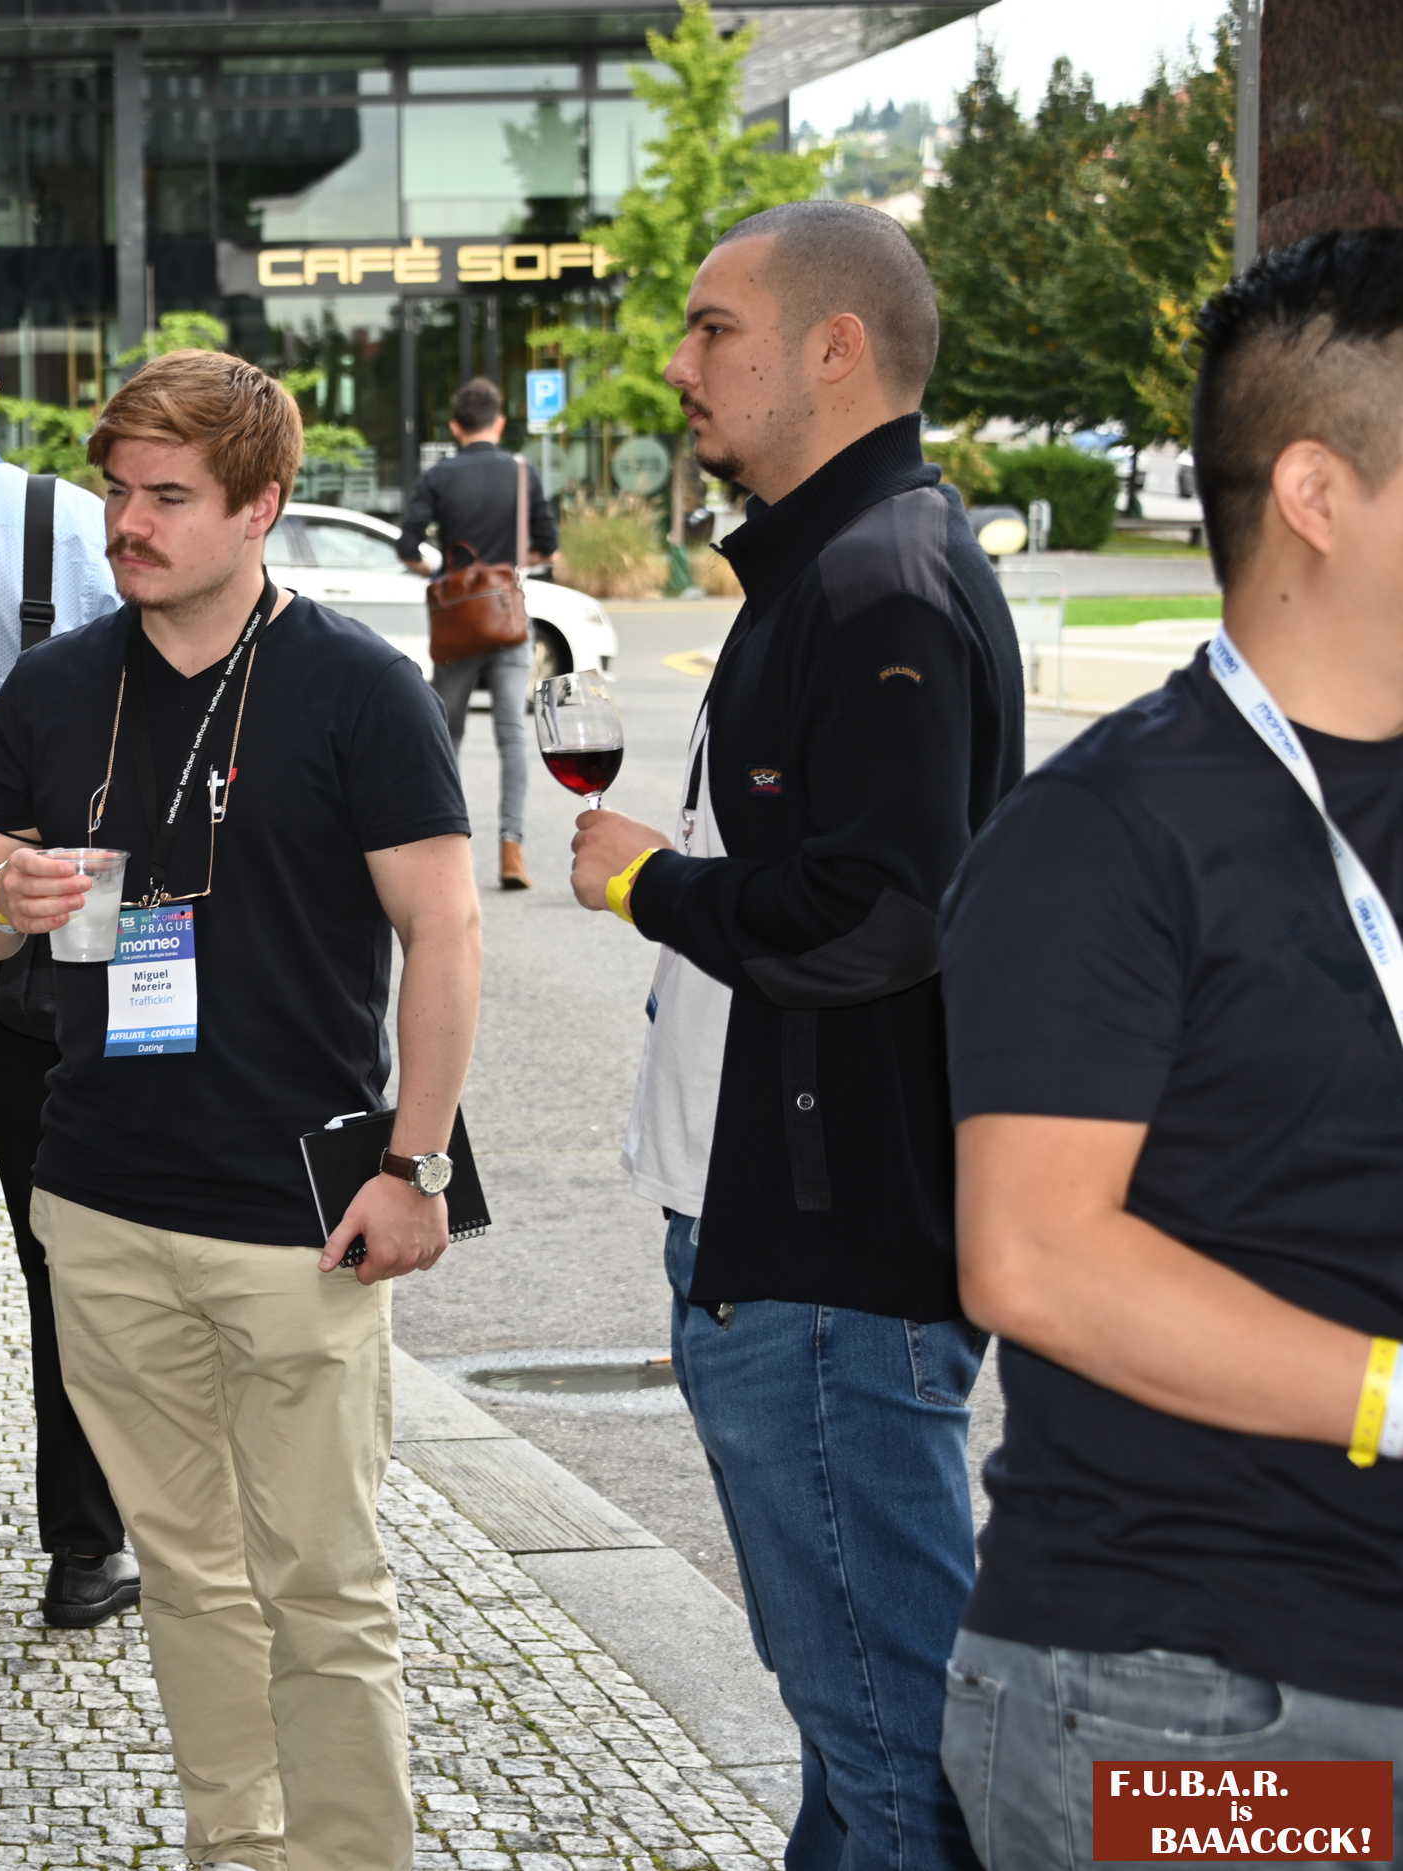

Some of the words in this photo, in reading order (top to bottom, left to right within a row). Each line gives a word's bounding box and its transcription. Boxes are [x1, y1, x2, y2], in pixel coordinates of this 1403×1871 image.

[258, 237, 441, 286] CAFÉ
[534, 380, 556, 408] P
[166, 788, 183, 824] traffickin'
[179, 751, 196, 786] traffickin'
[193, 715, 210, 749] traffickin'
[208, 679, 227, 712] traffickin'
[225, 644, 244, 675] traffickin'
[140, 920, 192, 934] PRAGUE
[120, 937, 180, 953] monneo
[134, 969, 168, 982] Miguel
[132, 981, 172, 992] Moreira
[110, 1031, 146, 1040] AFFILIATE
[151, 1027, 194, 1038] CORPORATE
[138, 1043, 164, 1053] Dating
